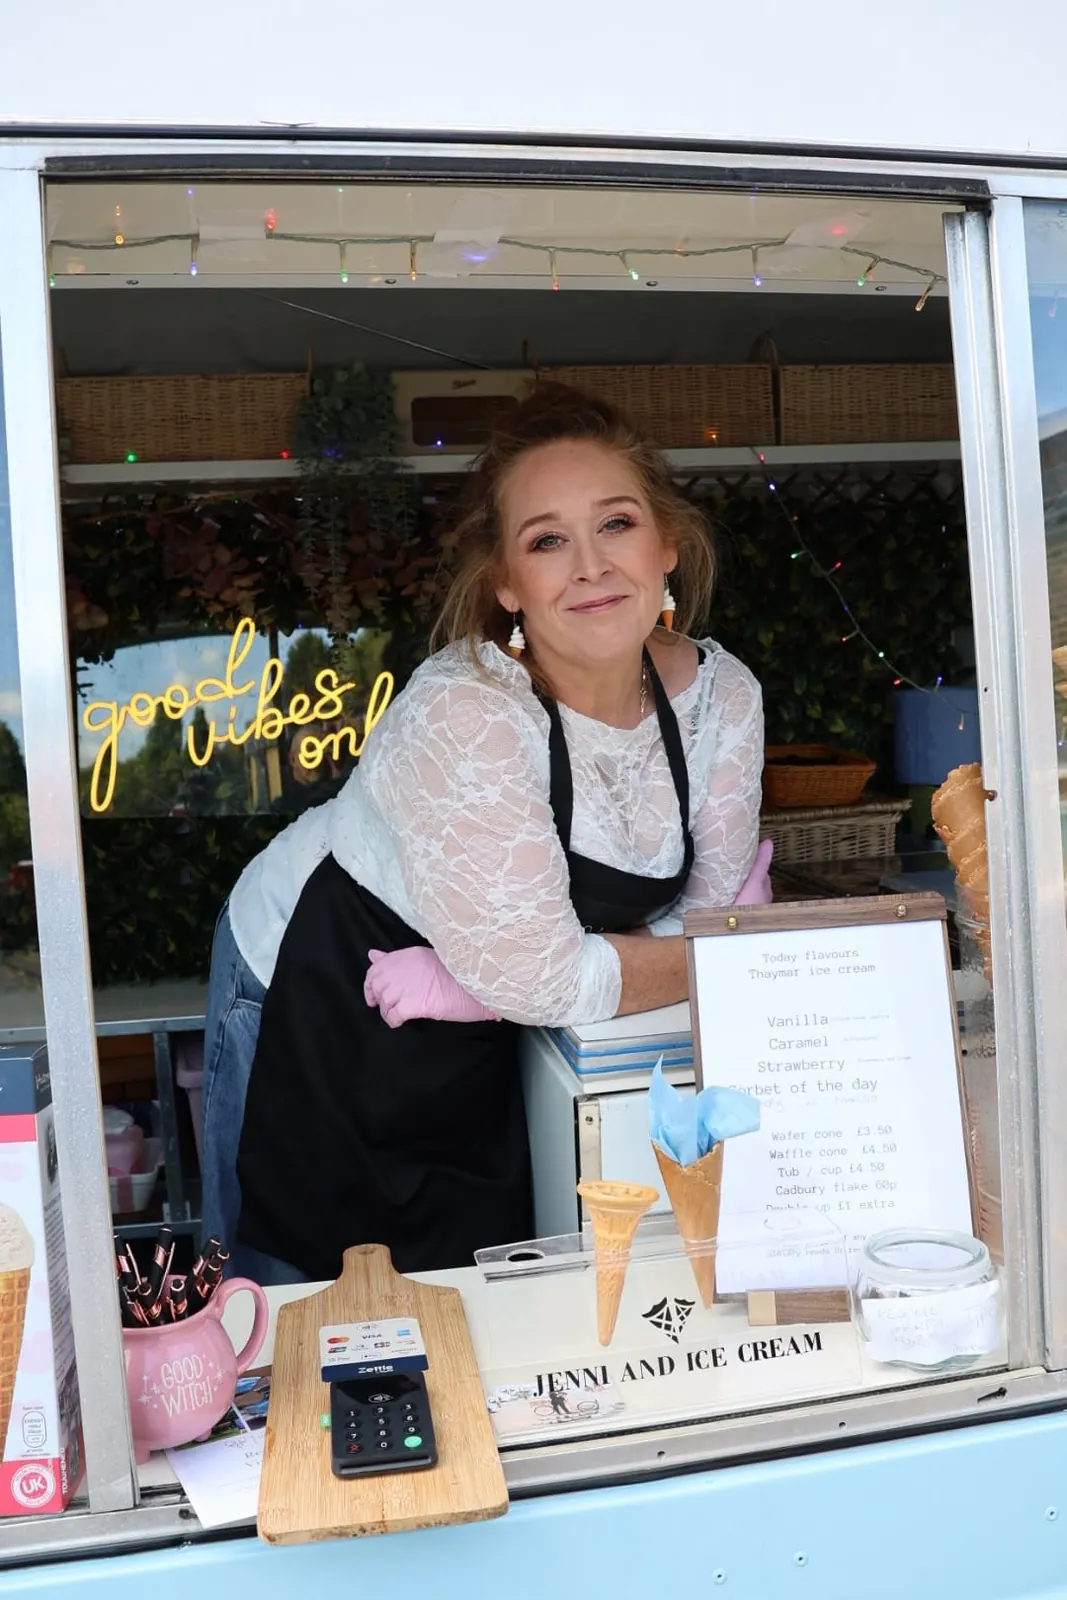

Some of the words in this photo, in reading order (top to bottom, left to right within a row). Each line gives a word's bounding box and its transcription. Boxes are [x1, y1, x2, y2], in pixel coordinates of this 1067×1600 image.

[82, 617, 256, 812] good
[187, 658, 356, 766] vibes
[298, 671, 395, 769] onl
[762, 953, 797, 963] Today
[805, 948, 859, 960] flavours
[748, 968, 801, 980] Thaymar
[809, 965, 830, 976] ice
[838, 964, 876, 974] cream
[767, 1013, 829, 1028] Vanilla
[769, 1036, 829, 1050] Caramel
[757, 1058, 846, 1074] Strawberry
[790, 1080, 807, 1094] of
[817, 1076, 843, 1092] the
[852, 1077, 878, 1093] day
[771, 1130, 807, 1142] Wafer
[814, 1129, 843, 1139] cone
[856, 1125, 893, 1137] £3.50
[769, 1148, 812, 1160] Waffle
[819, 1146, 848, 1157] cone
[862, 1143, 898, 1154] £4.50
[777, 1166, 800, 1178] Tub
[820, 1165, 843, 1176] cup
[849, 1162, 885, 1173] £450
[775, 1184, 825, 1197] Cadbury
[834, 1180, 869, 1193] flake
[859, 1198, 895, 1210] extra
[160, 1354, 203, 1388] GOOD
[533, 1365, 610, 1398] JENNI
[621, 1355, 675, 1382] AND
[687, 1347, 727, 1371] ICE
[738, 1332, 823, 1362] CREAM
[160, 1376, 212, 1417] WITCH
[22, 1476, 46, 1494] UK
